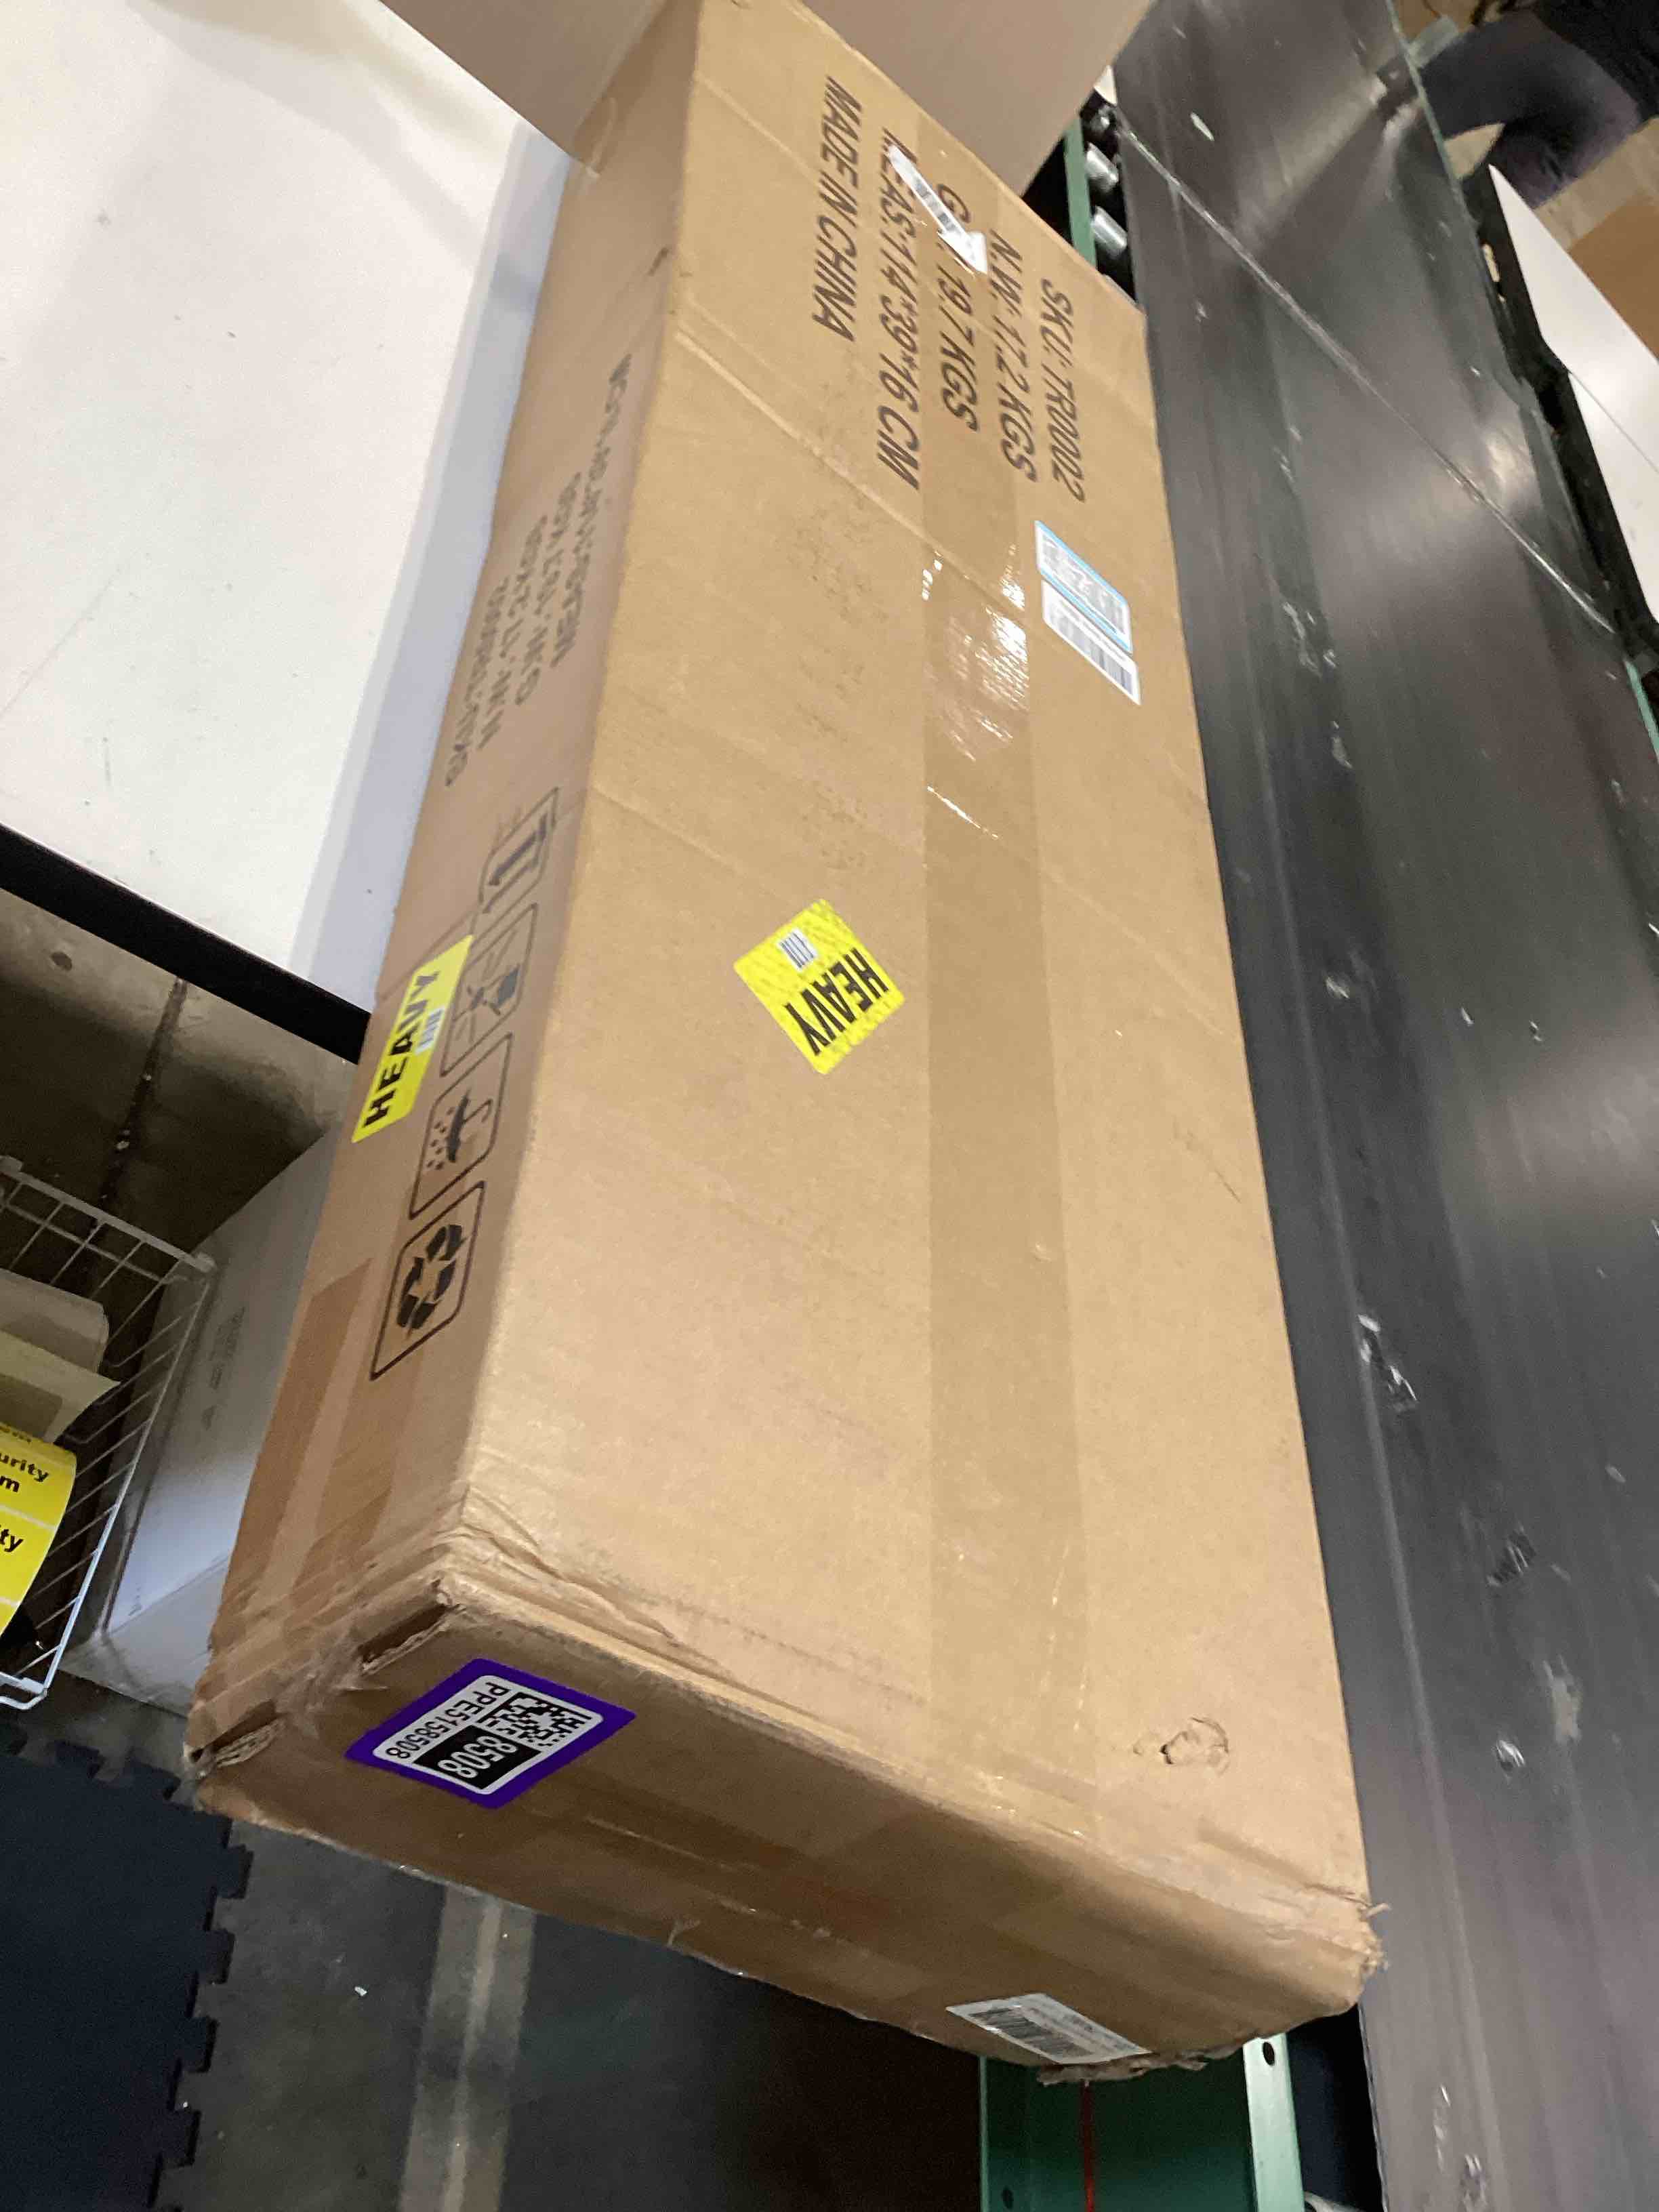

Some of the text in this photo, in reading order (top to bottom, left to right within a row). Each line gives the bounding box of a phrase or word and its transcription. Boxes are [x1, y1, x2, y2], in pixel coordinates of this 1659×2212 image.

[813, 75, 861, 342] MADE IN CHINA
[938, 263, 975, 347] 19.7
[989, 229, 1038, 483] N.W: 17.2 KGS
[1040, 278, 1073, 371] SKU:
[940, 330, 979, 432] KGS
[877, 405, 920, 489] CM
[1041, 362, 1086, 503] TR0002
[363, 971, 441, 1128] HEAVY
[784, 947, 889, 1056] HEAVY
[386, 1681, 510, 1759] PPE5158508
[437, 1735, 518, 1779] 8508
